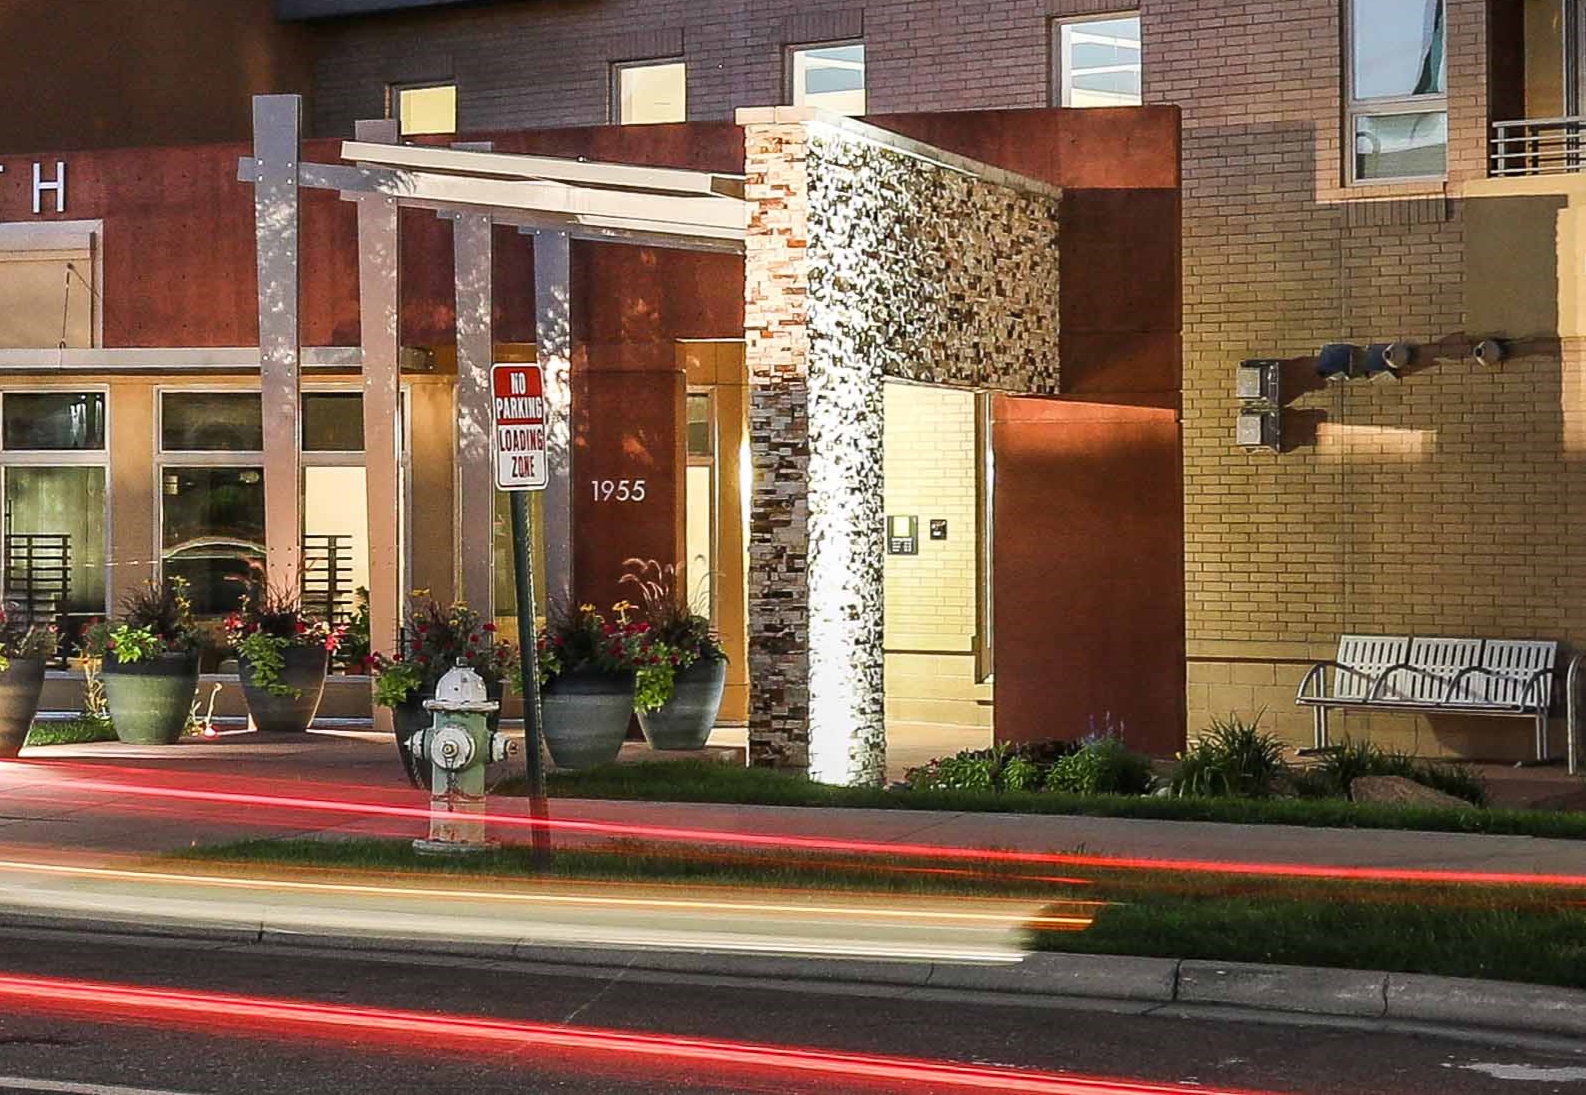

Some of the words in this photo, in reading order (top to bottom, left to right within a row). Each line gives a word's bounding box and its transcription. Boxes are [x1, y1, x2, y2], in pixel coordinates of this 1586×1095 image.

[510, 372, 526, 394] NO
[496, 397, 543, 419] PARKING
[499, 429, 543, 452] LOADING
[511, 456, 535, 478] ZONE
[591, 480, 646, 502] 1955
